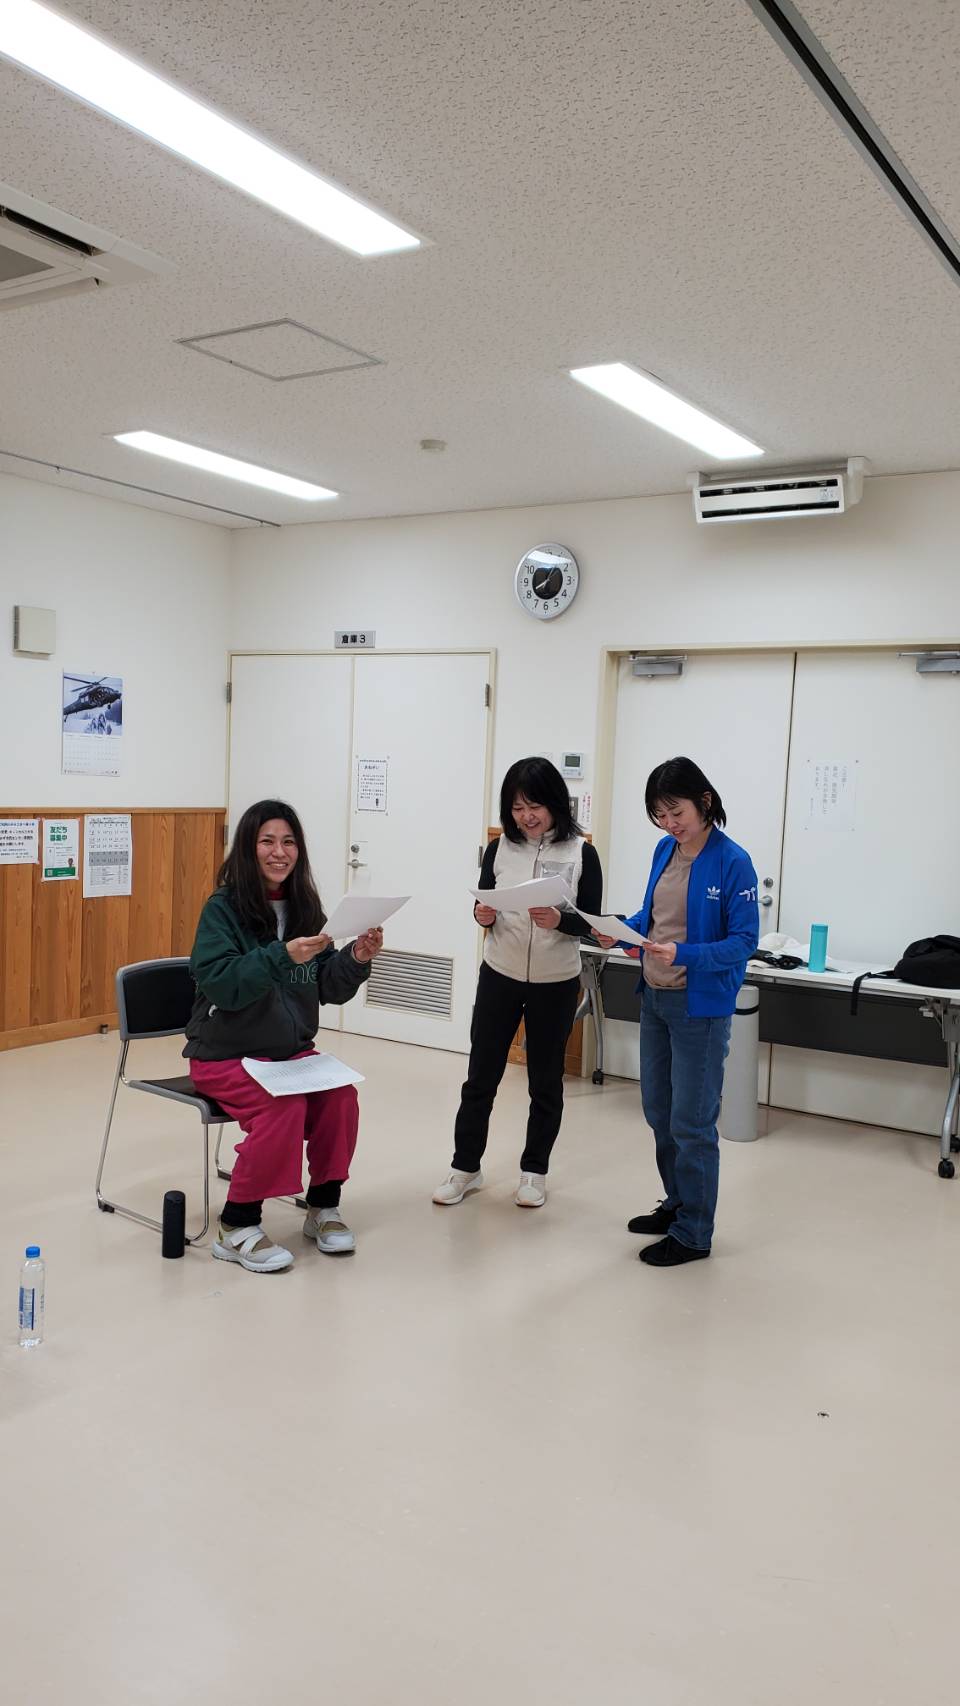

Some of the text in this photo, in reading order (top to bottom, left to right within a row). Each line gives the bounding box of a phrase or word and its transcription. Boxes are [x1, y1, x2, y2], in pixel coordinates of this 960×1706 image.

[527, 565, 535, 574] 10
[563, 563, 569, 573] 2
[523, 578, 529, 587] 9
[566, 576, 572, 585] 3
[526, 590, 532, 599] 8
[561, 589, 567, 598] 4
[534, 599, 539, 608] 7
[543, 601, 549, 610] 6
[553, 598, 559, 607] 5
[50, 826, 68, 834] 友だち
